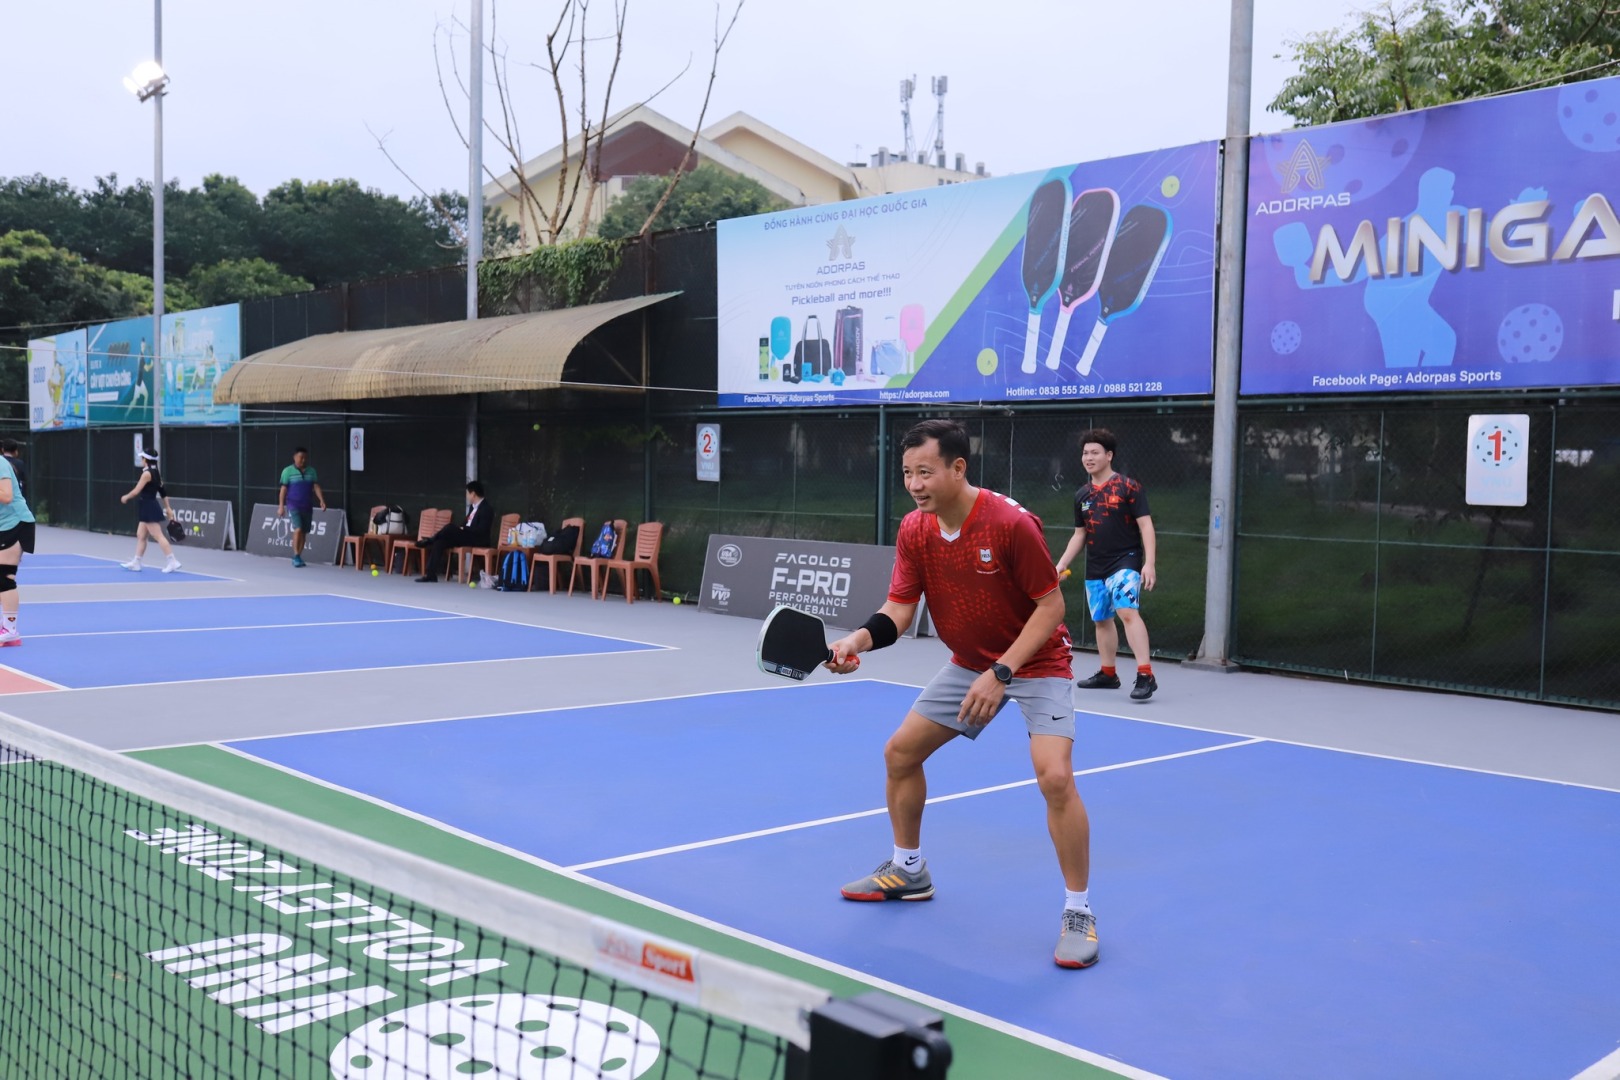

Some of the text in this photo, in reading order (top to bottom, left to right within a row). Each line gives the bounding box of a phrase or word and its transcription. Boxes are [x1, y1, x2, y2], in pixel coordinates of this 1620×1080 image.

[790, 214, 812, 227] HÀNH
[815, 212, 839, 223] CÙNG
[841, 208, 857, 220] ĐẠI
[860, 205, 878, 218] HỌC
[881, 198, 908, 213] QUỐC
[911, 198, 928, 209] GIA
[1255, 192, 1351, 216] ADORPAS
[816, 262, 866, 276] ADORPAS
[792, 287, 892, 305] Pickleball and more!!!
[1313, 370, 1501, 387] Facebook Page: Adorpas Sports
[880, 390, 949, 400] https://adorpas.com
[1006, 387, 1037, 396] Hotline:
[1039, 386, 1060, 395] 0838
[1062, 385, 1077, 394] 555
[1079, 384, 1095, 394] 268
[1104, 383, 1126, 393] 0988
[1129, 383, 1143, 392] 521
[1145, 382, 1162, 391] 228
[744, 395, 770, 403] Facebook
[789, 394, 813, 404] Adorpas
[814, 393, 834, 403] Sports
[704, 434, 711, 452] 2
[1488, 431, 1501, 461] 1
[775, 553, 852, 568] FACOLOS
[771, 567, 851, 596] F-PRO
[769, 591, 848, 608] PERFORMANCE
[123, 824, 301, 880] ZONE
[233, 882, 509, 987] VOLLEY
[142, 933, 398, 1035] VNU
